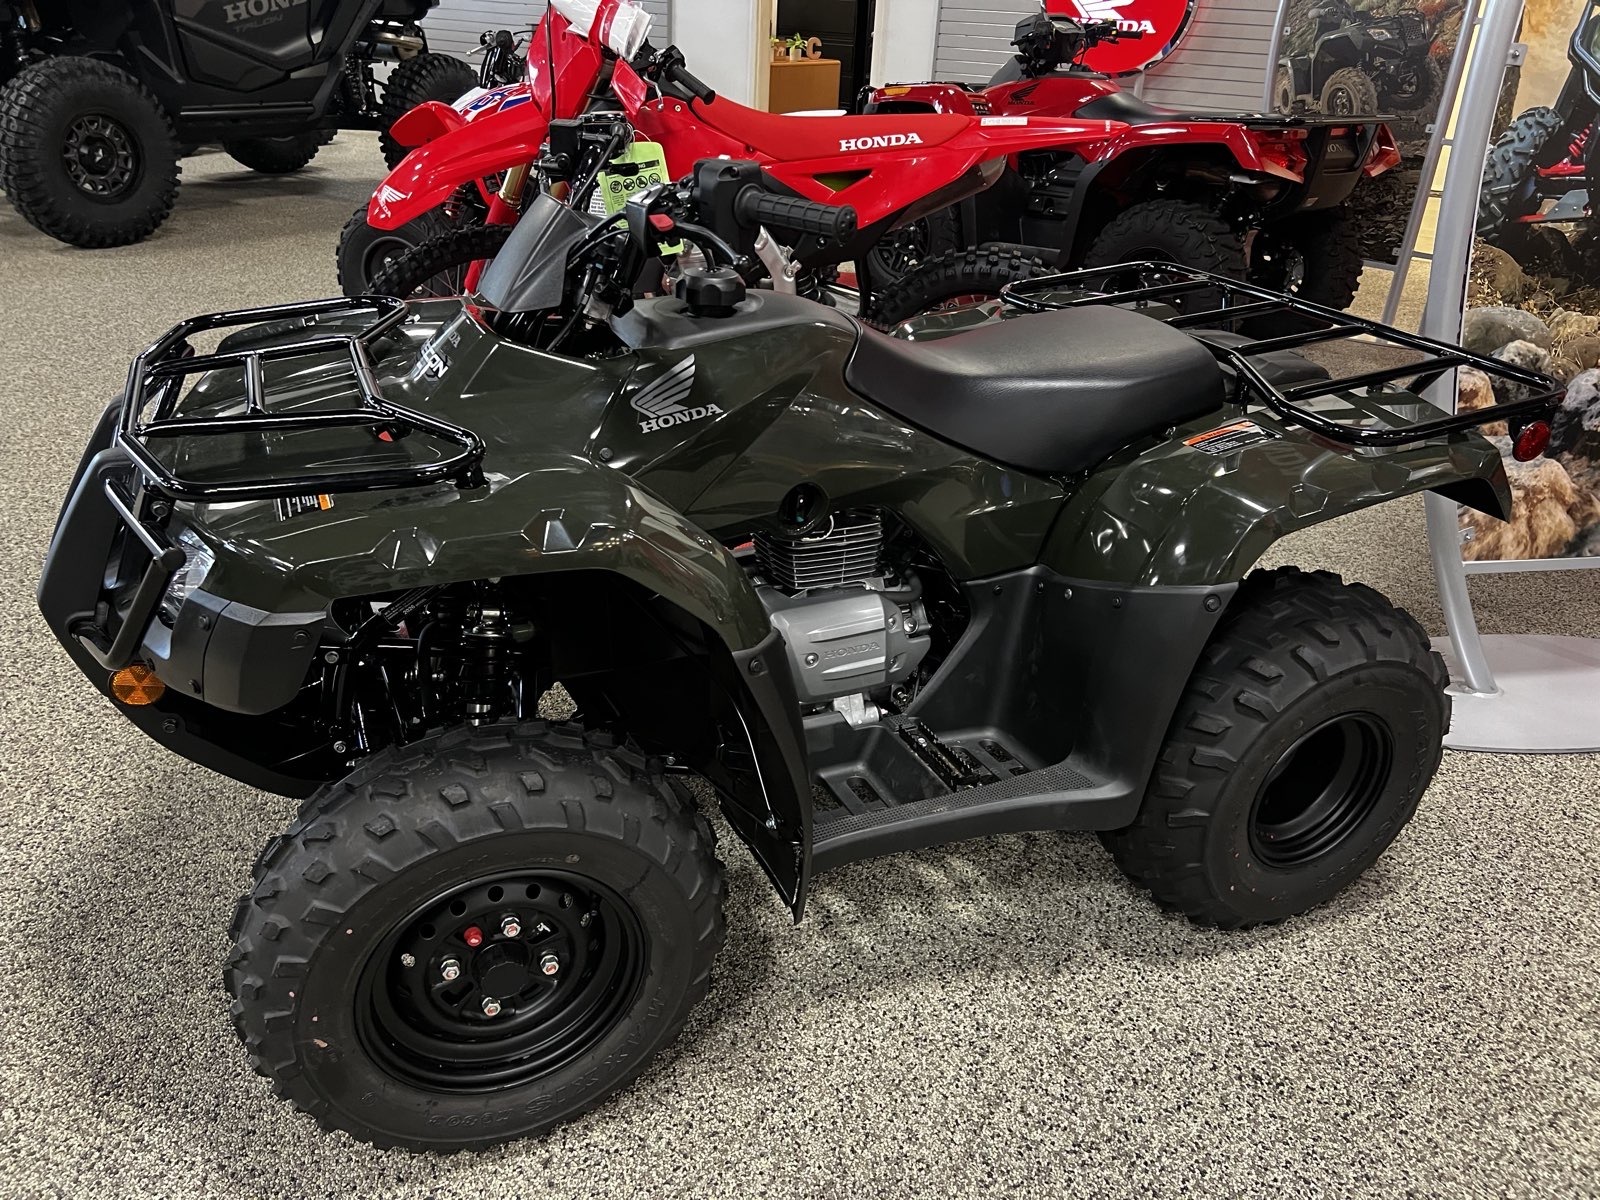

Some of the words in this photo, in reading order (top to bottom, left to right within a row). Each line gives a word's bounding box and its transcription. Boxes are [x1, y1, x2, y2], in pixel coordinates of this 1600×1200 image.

[806, 36, 822, 60] C
[839, 132, 923, 151] HONDA
[639, 403, 724, 434] HONDA
[824, 641, 881, 660] HONDA
